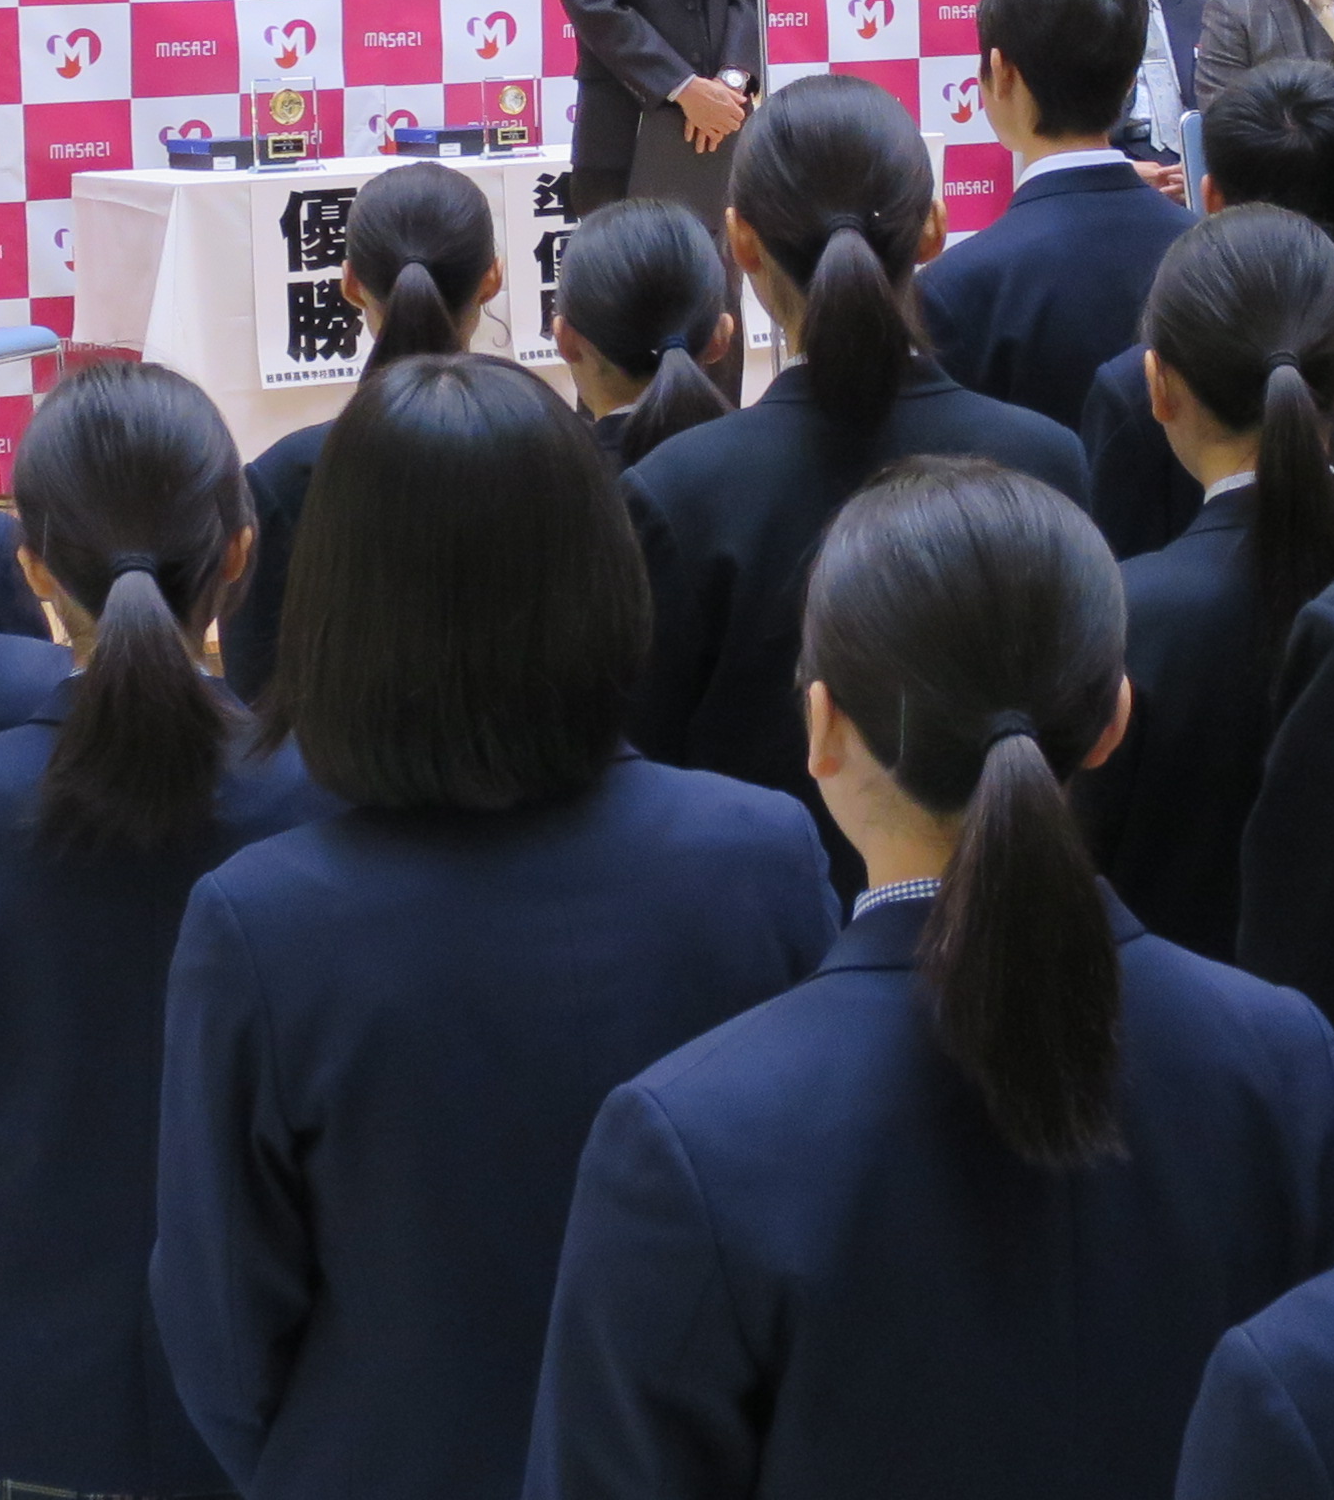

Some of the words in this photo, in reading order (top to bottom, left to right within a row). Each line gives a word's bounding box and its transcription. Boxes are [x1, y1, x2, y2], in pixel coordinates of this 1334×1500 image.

[768, 11, 809, 28] ASA21
[938, 4, 977, 21] MASA
[155, 40, 217, 58] MASA21
[363, 31, 422, 49] MASA21
[49, 141, 111, 160] MASA21
[943, 179, 995, 197] MASA21
